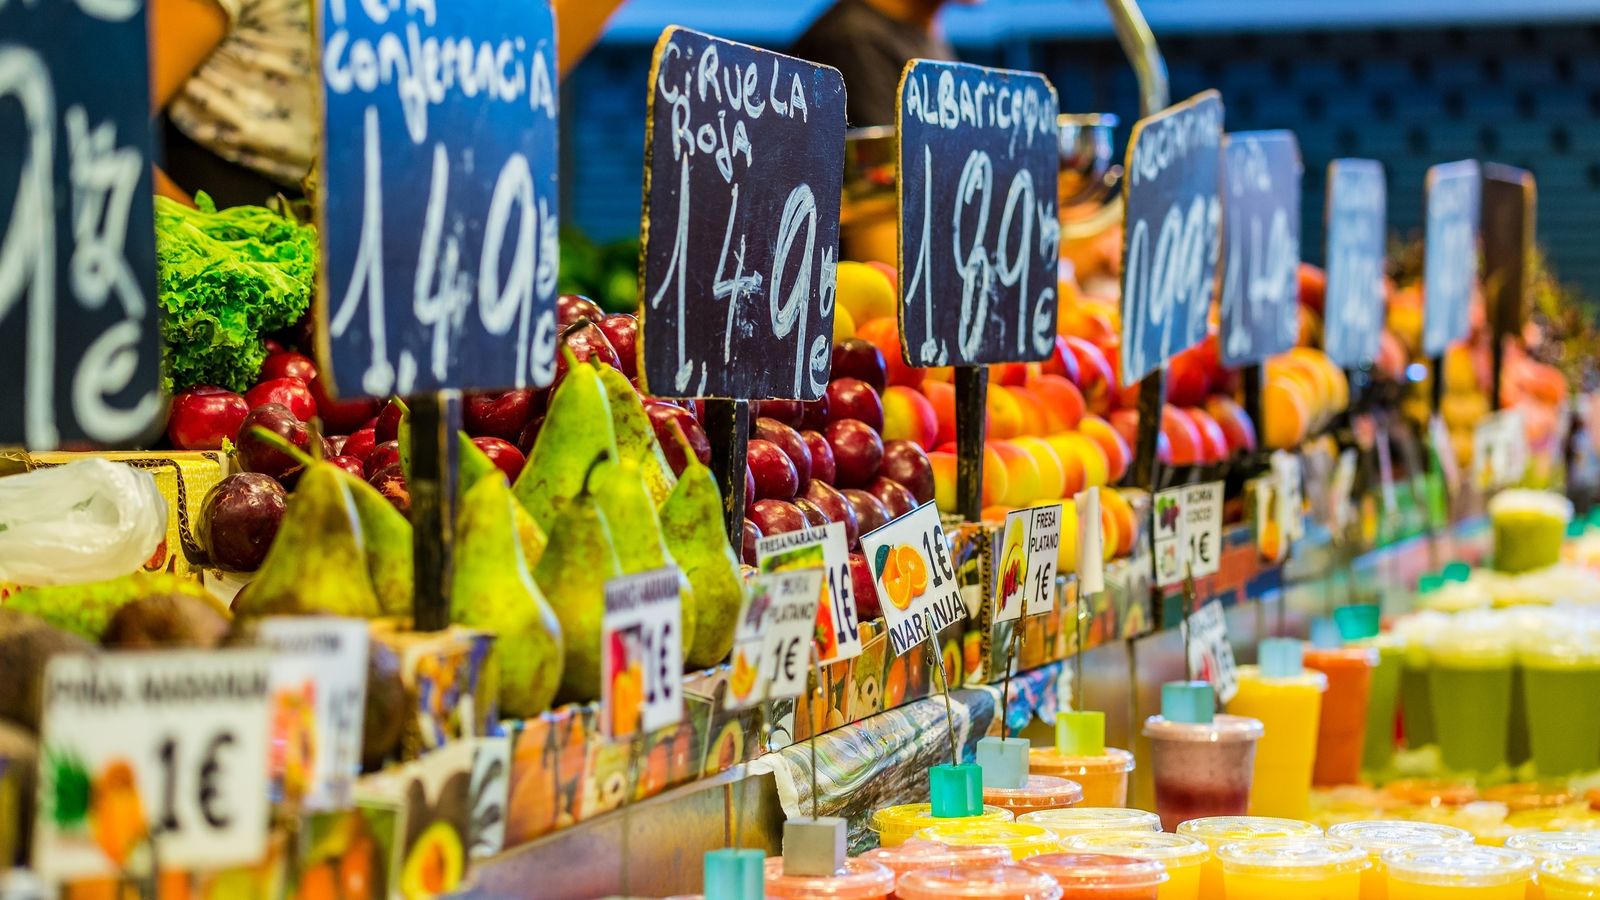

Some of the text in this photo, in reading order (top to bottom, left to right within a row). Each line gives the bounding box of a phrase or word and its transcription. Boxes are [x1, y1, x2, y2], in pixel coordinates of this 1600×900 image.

[760, 527, 829, 554] FRESA NARANJA
[1036, 511, 1056, 529] FRESA
[922, 525, 954, 589] 1€
[1030, 533, 1059, 553] PLATANO
[1190, 531, 1210, 566] 1€
[1034, 562, 1052, 602] 1€
[829, 563, 859, 645] 1€
[889, 590, 966, 655] NARANJA
[772, 636, 800, 682] 1€
[156, 728, 238, 833] 1€
